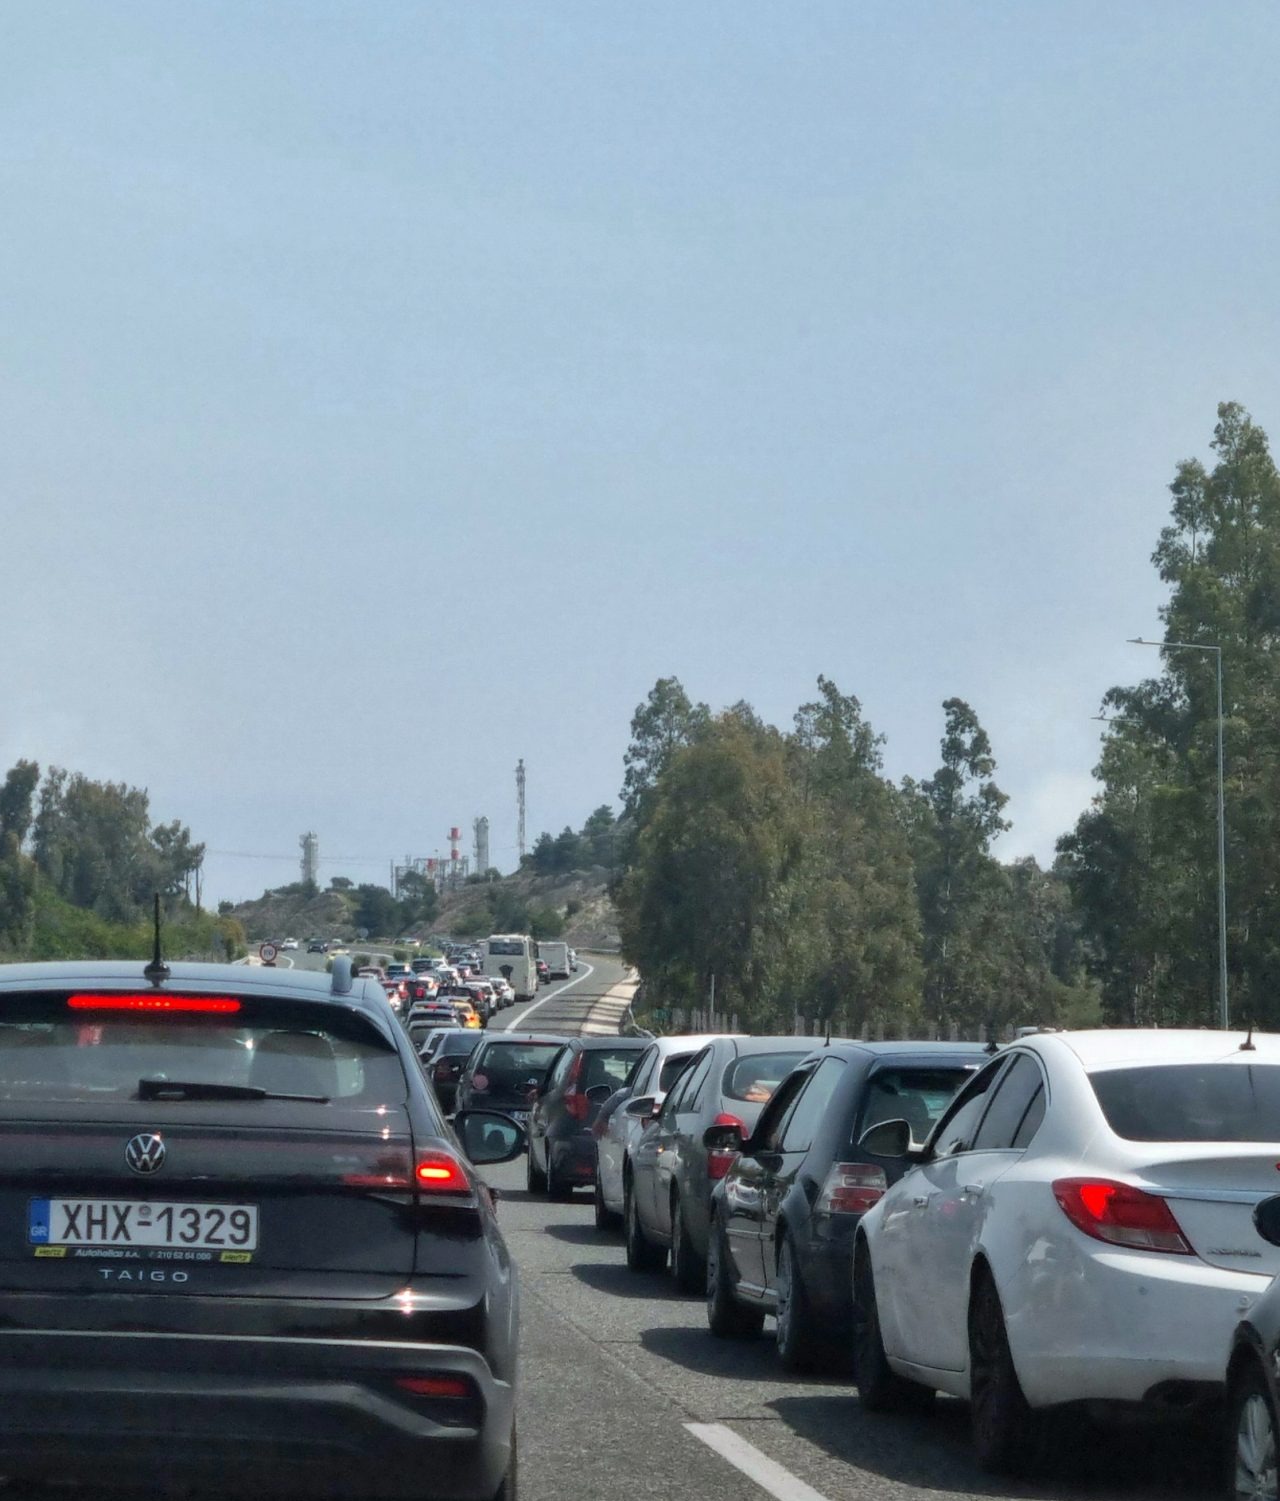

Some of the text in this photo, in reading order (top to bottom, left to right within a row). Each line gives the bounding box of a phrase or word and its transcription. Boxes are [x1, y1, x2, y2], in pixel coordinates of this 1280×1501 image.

[31, 1226, 48, 1237] GR
[62, 1204, 251, 1245] XHX-1329
[98, 1268, 189, 1282] TAIGO
